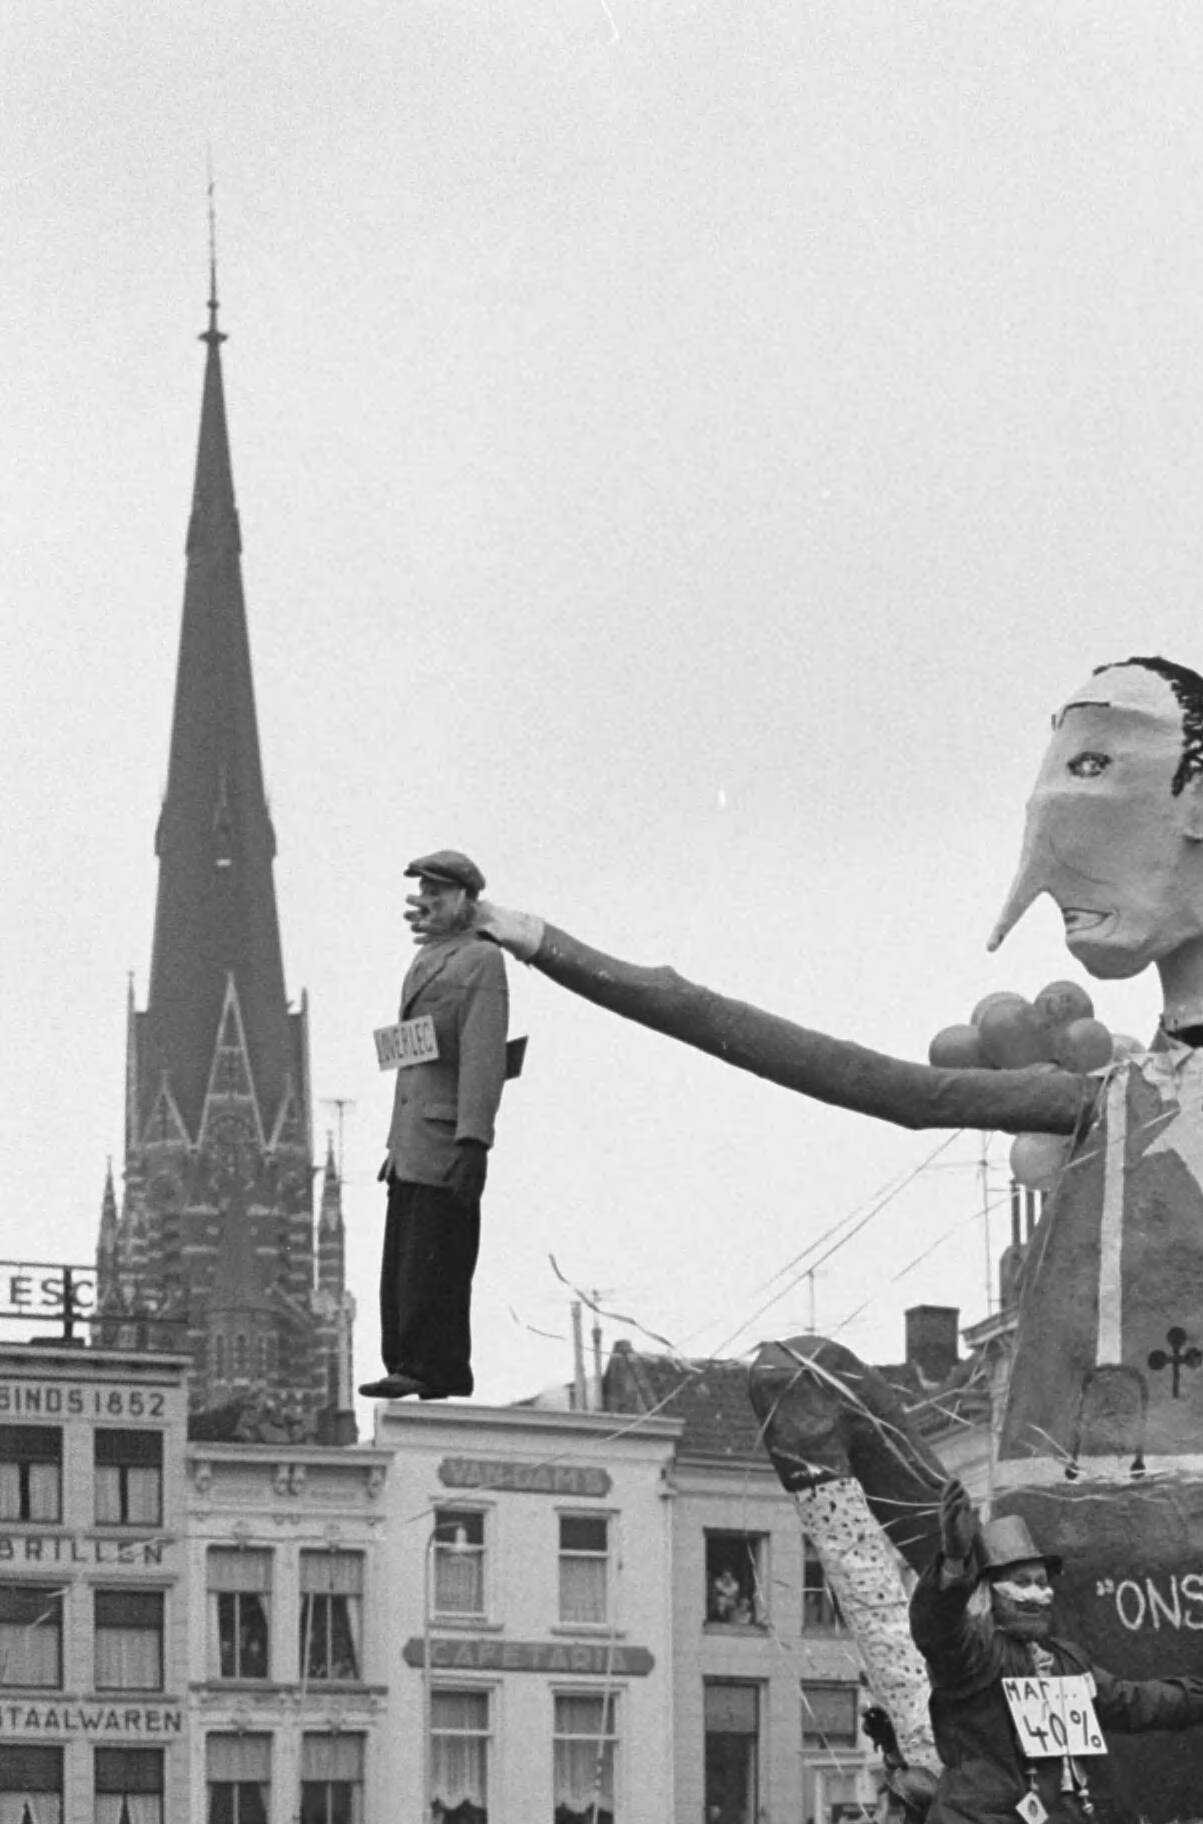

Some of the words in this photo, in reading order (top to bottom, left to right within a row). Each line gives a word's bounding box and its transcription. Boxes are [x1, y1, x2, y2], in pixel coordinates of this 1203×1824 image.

[94, 1391, 166, 1417] 1852
[0, 1706, 182, 1732] TAALWAREN
[1022, 1708, 1103, 1753] 40%
